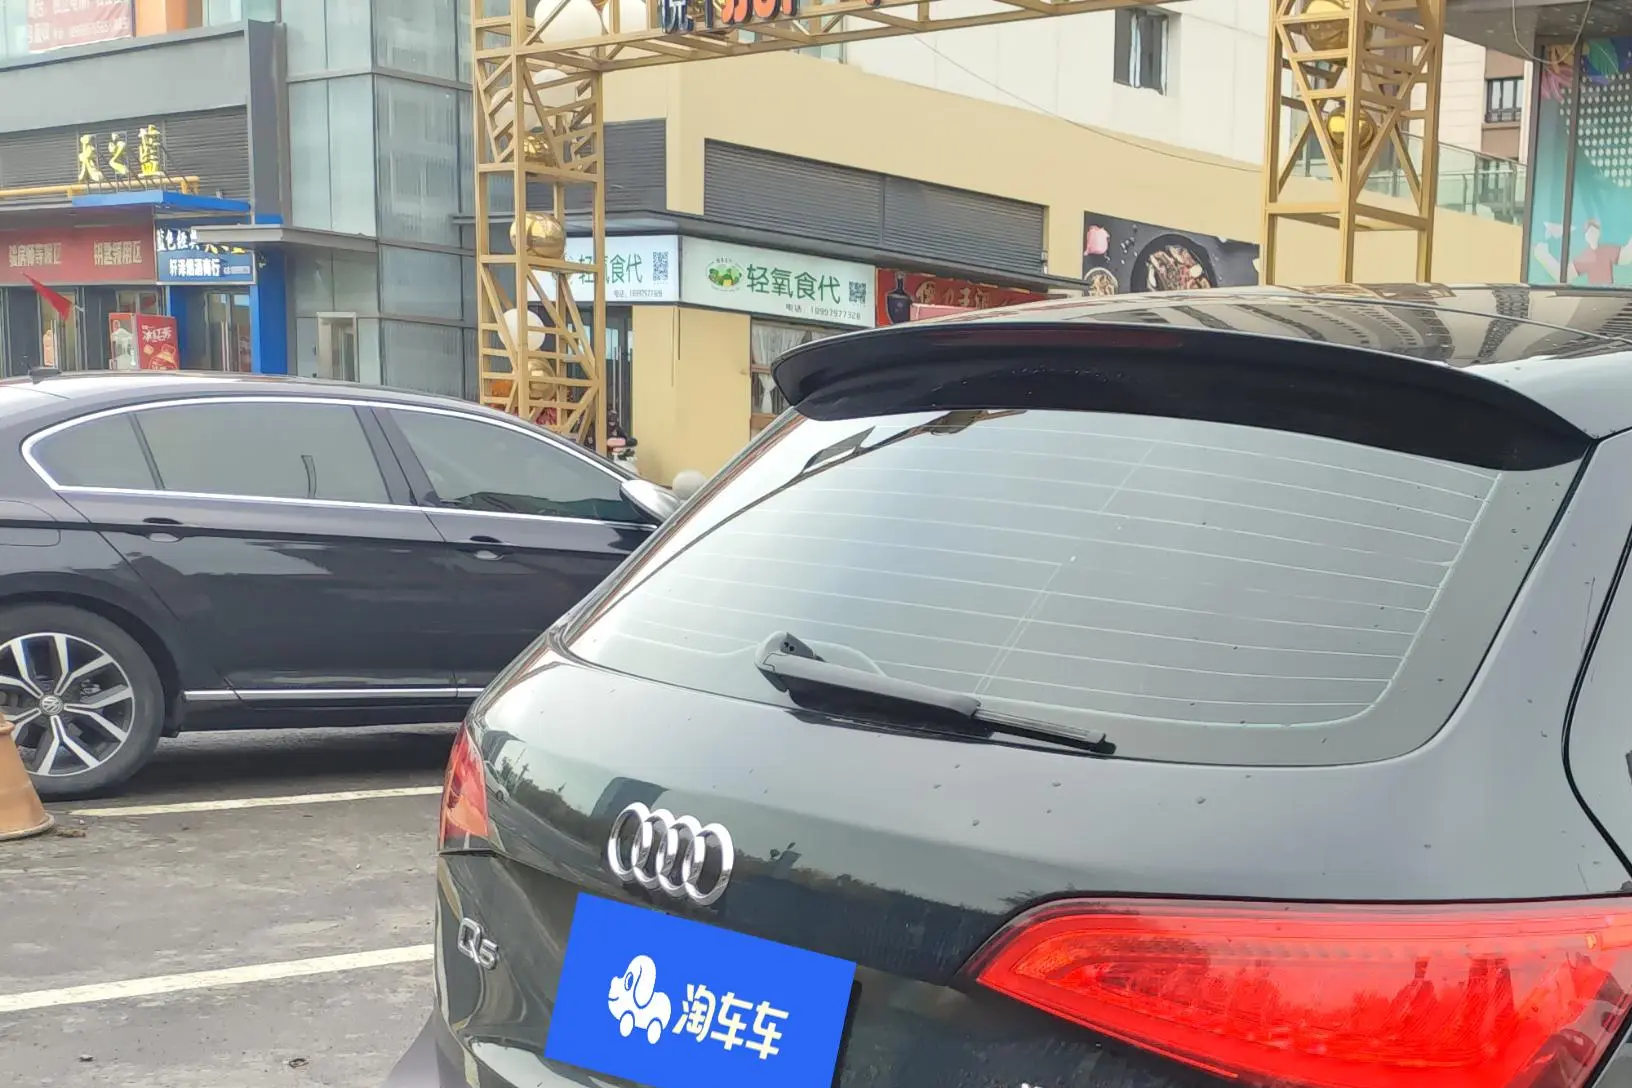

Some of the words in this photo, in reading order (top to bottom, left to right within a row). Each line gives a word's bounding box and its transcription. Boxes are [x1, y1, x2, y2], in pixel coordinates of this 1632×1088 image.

[78, 124, 165, 181] 天之蓝
[746, 263, 841, 304] 轻氧食代
[457, 916, 499, 971] Q5
